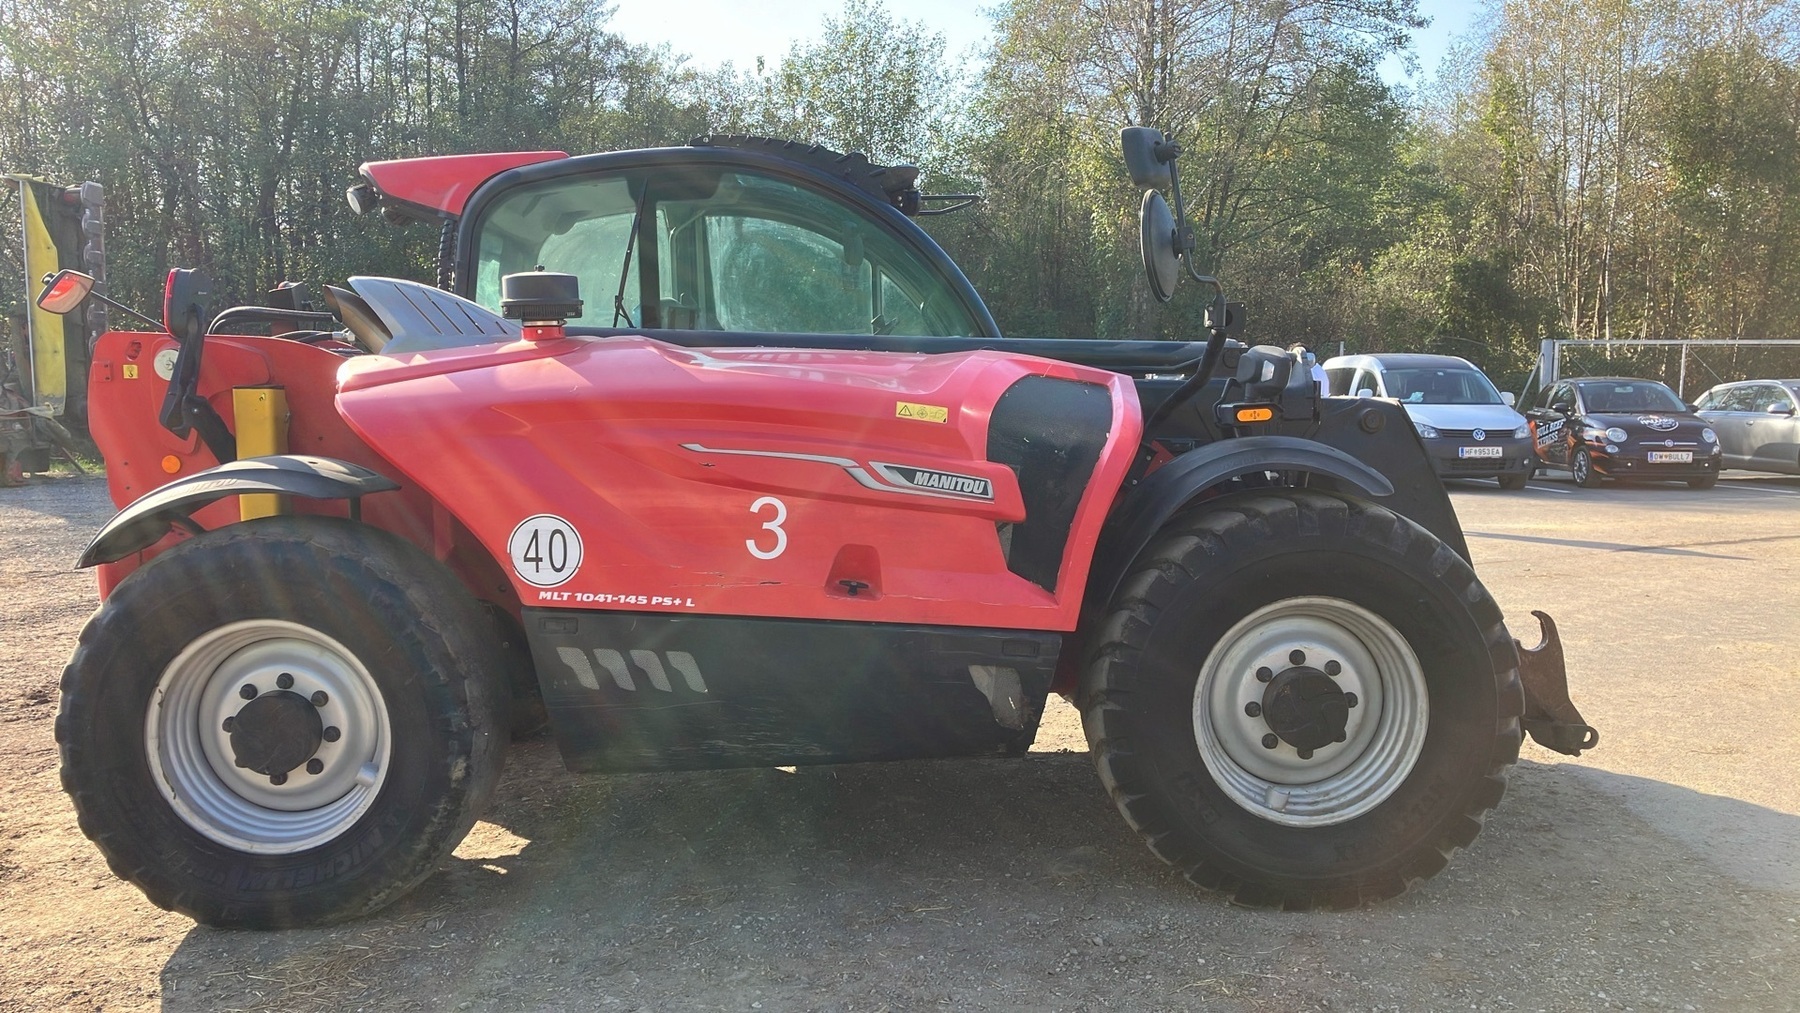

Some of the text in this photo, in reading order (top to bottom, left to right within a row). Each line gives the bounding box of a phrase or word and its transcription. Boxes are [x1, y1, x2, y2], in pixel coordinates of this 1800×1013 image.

[913, 471, 985, 494] MANITOU
[745, 496, 788, 560] 3
[523, 528, 568, 573] 40
[538, 591, 696, 607] MLT 1041-145 PS+ L
